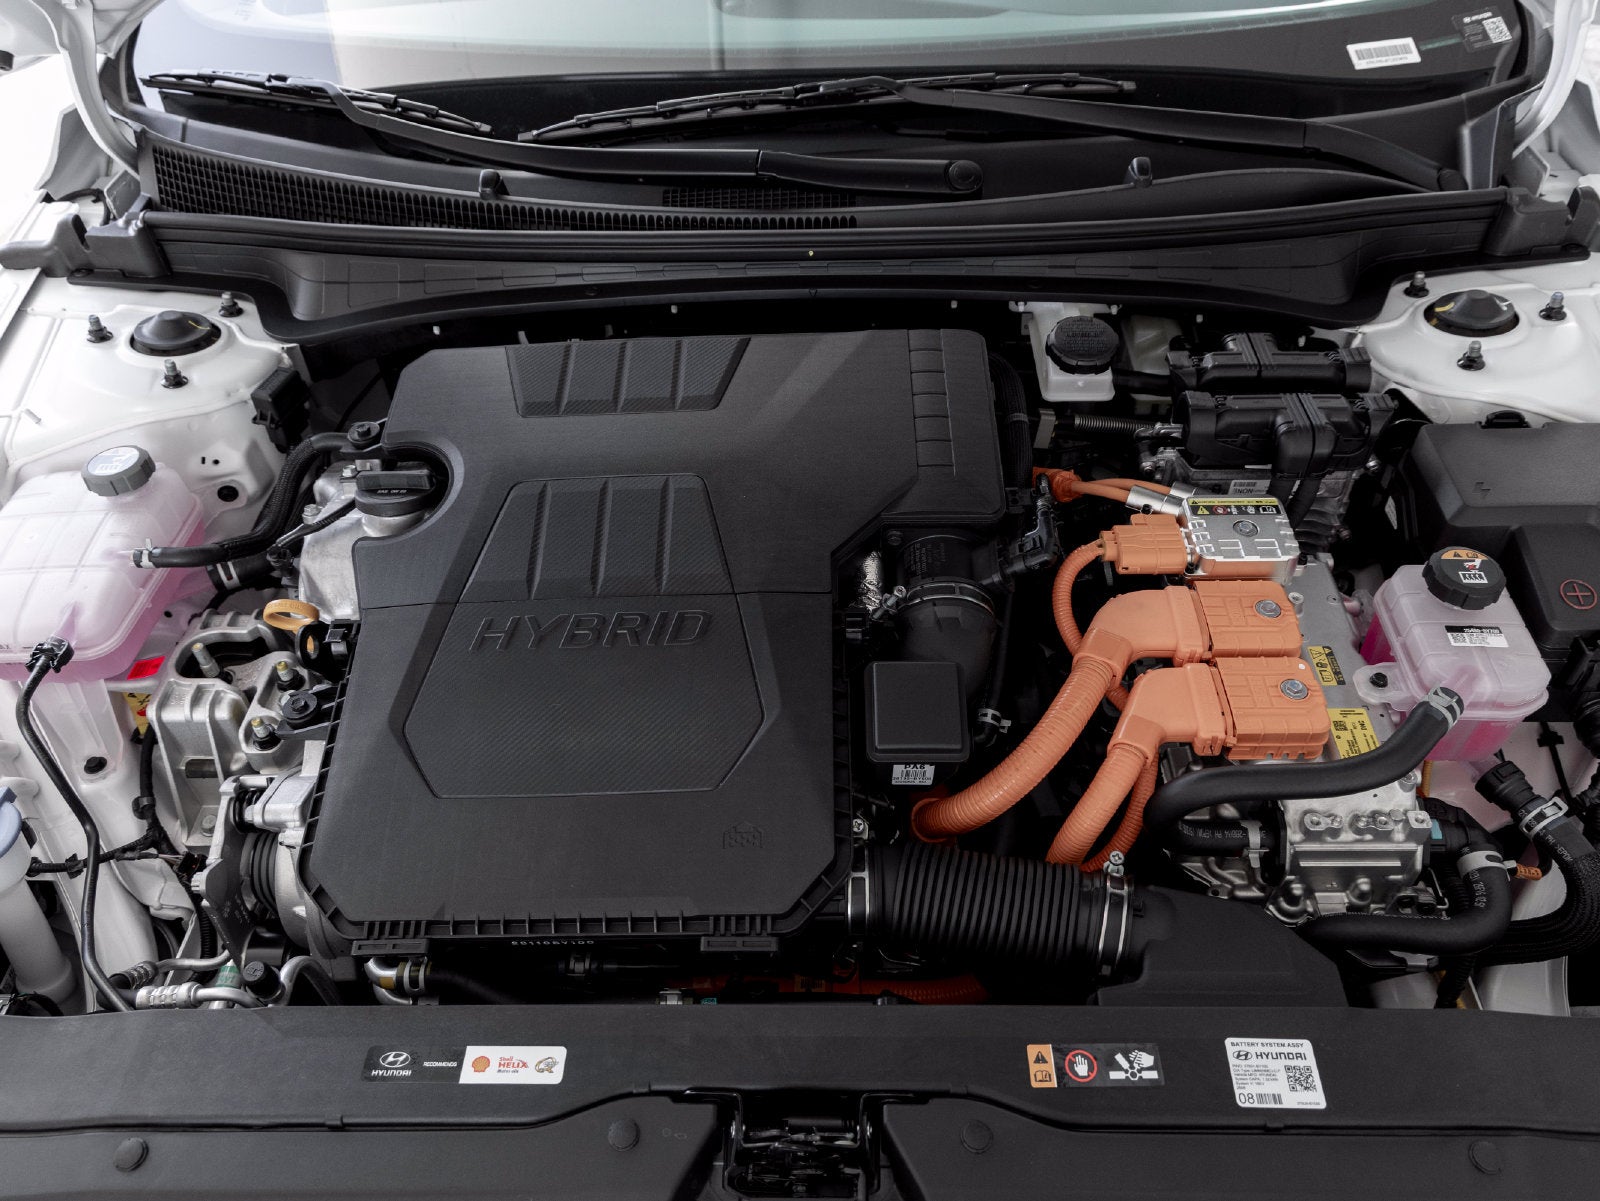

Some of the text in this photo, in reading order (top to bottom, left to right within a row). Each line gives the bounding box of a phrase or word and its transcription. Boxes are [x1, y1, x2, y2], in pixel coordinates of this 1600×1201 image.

[469, 610, 713, 650] HYBRID
[1255, 1051, 1307, 1061] HYUNDAI
[497, 1060, 529, 1068] HELIX
[371, 1069, 412, 1077] HYUNDAI
[1238, 1092, 1255, 1104] 08
